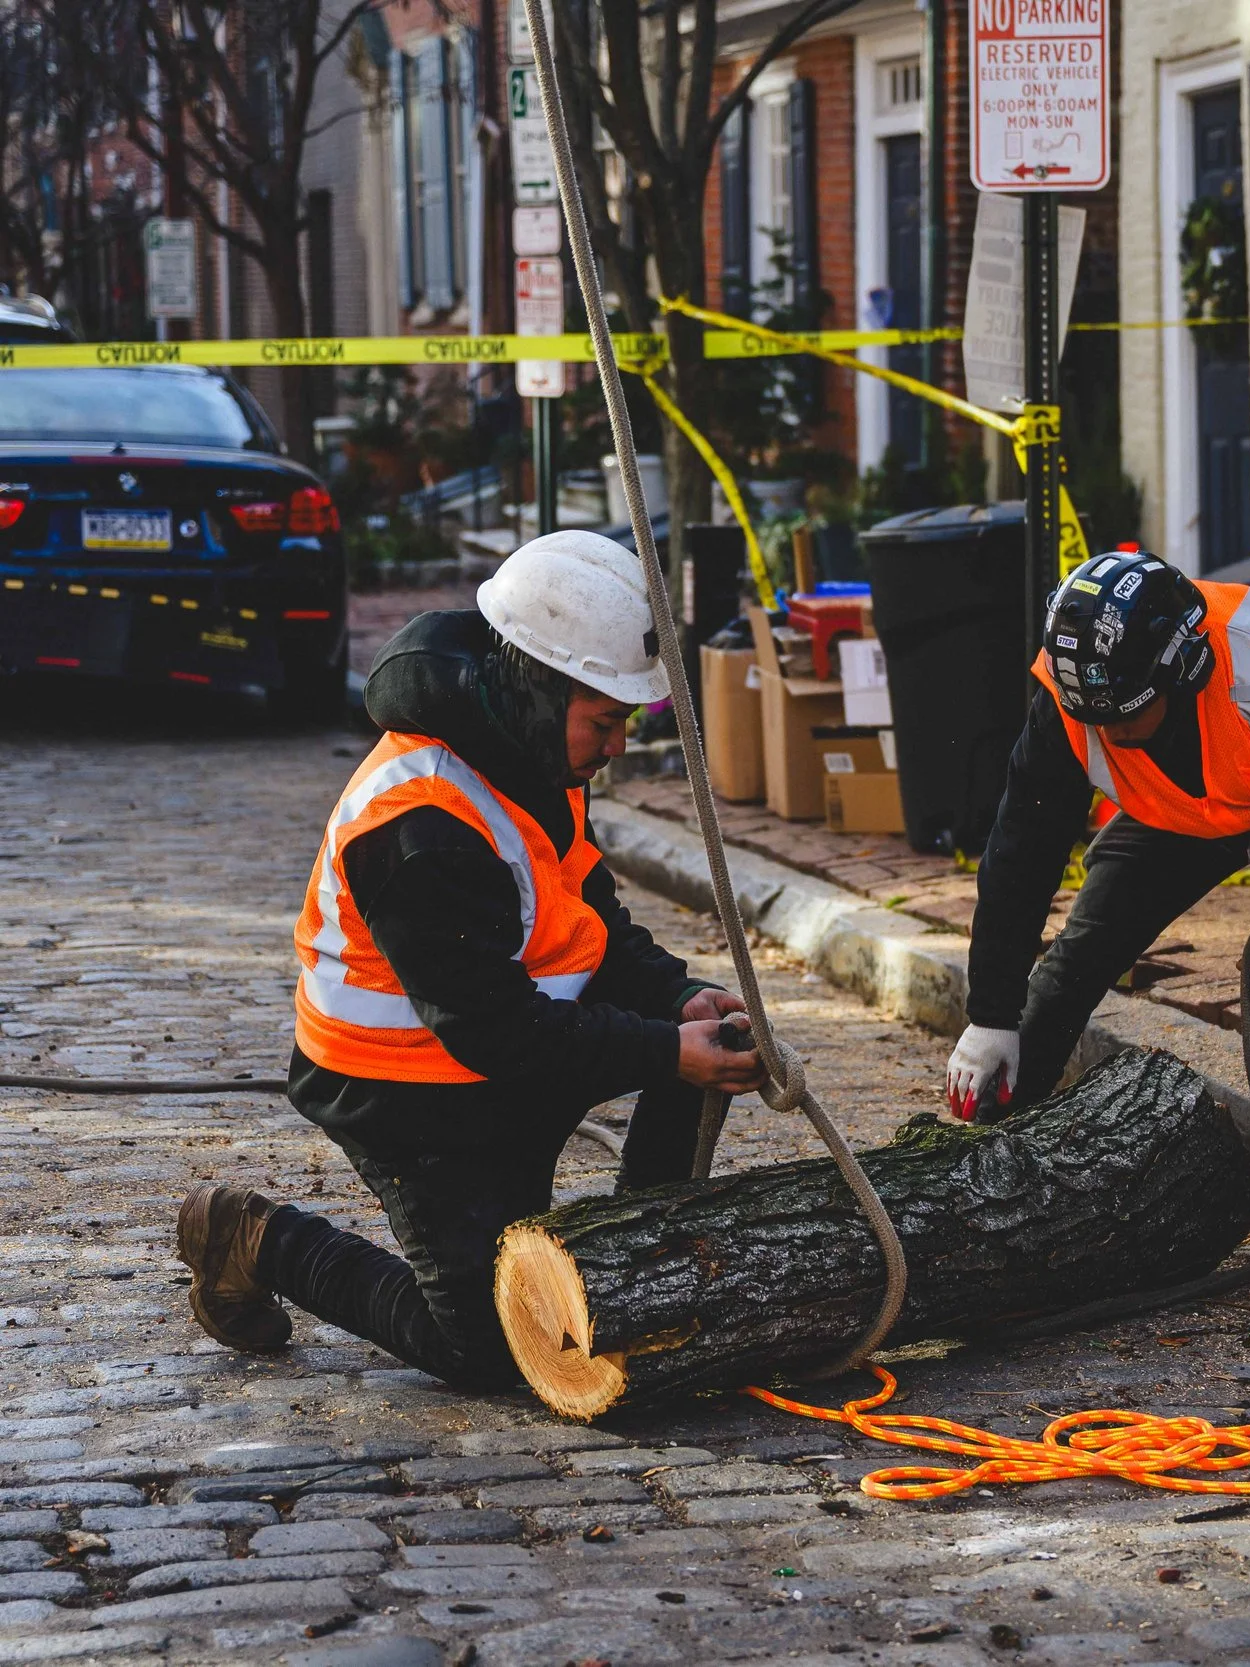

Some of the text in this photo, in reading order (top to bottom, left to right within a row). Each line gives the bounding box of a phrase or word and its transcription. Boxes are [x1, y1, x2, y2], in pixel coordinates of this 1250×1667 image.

[978, 0, 1099, 32] NO PARKING
[987, 42, 1093, 64] RESERVED
[981, 65, 1099, 81] ELECTRIC VEHICLE
[1022, 83, 1058, 97] ONLY
[983, 98, 1097, 113] 6:00PM-6:00AM
[1007, 115, 1074, 129] MON-SUN
[1117, 573, 1140, 598] PETZL
[1190, 648, 1208, 679] SENA
[1121, 689, 1154, 712] NOTCH
